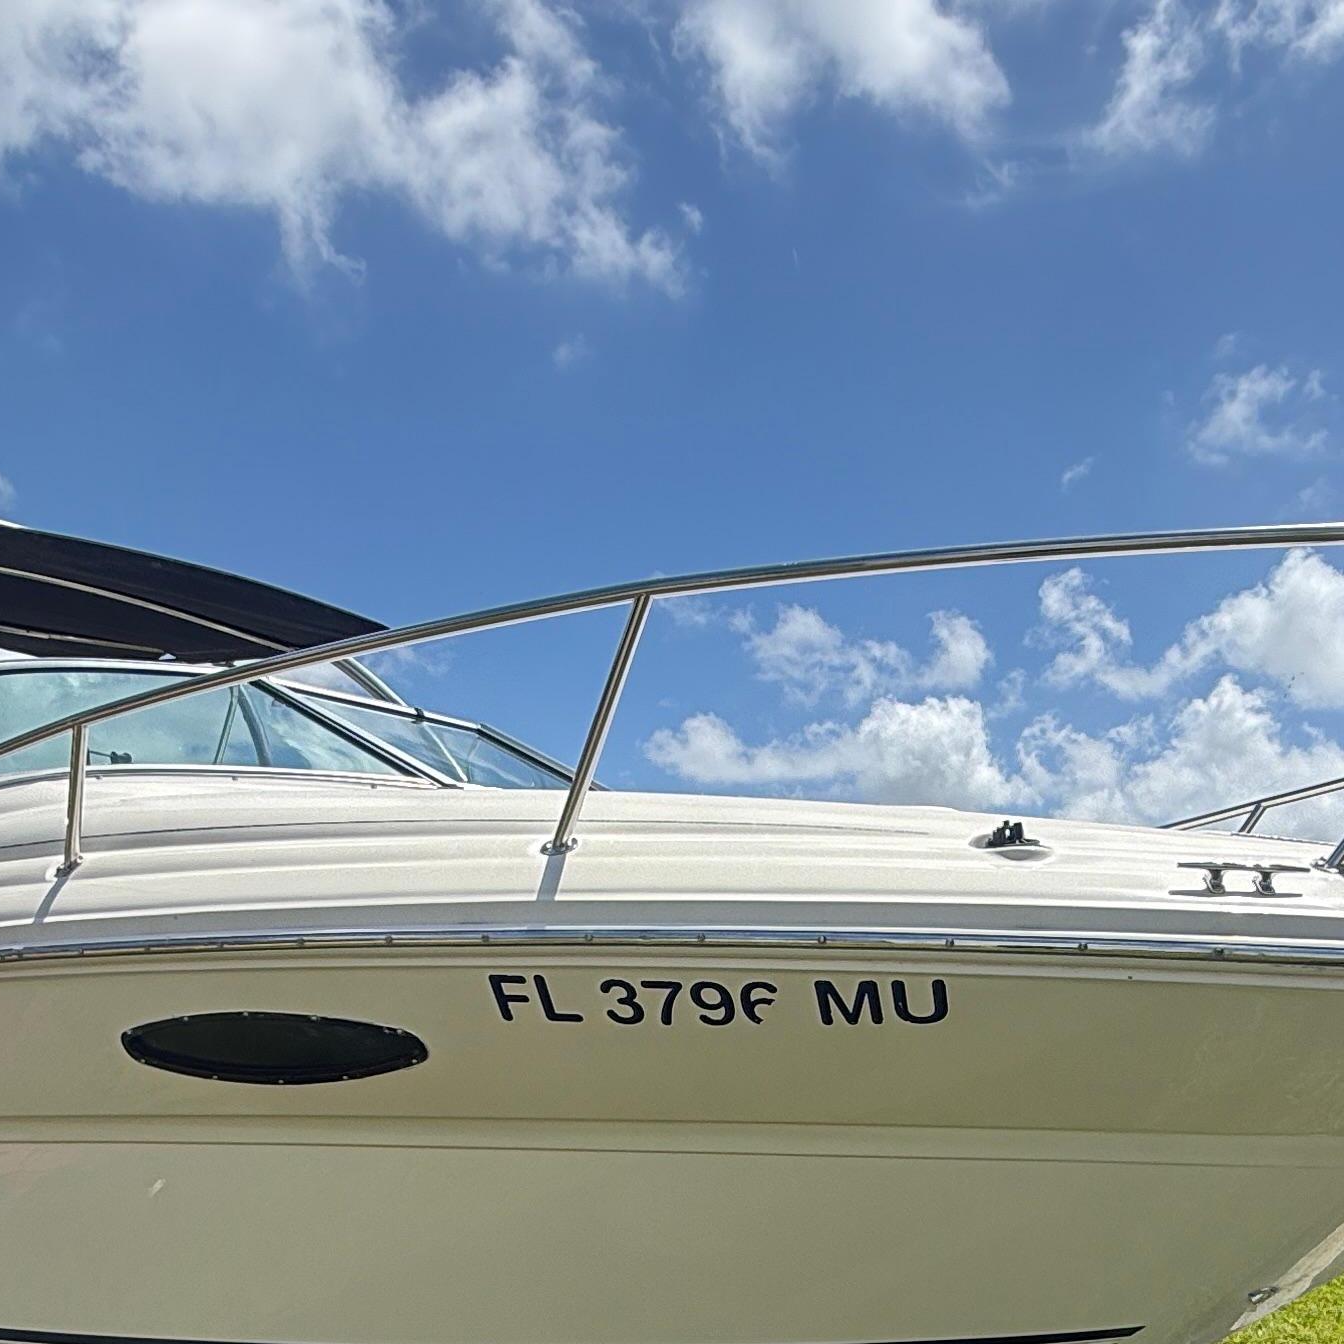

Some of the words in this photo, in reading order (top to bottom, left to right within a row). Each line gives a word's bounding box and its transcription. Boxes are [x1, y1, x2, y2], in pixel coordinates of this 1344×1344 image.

[488, 974, 584, 1023] FL
[600, 979, 778, 1026] 3796
[814, 979, 950, 1026] MU
